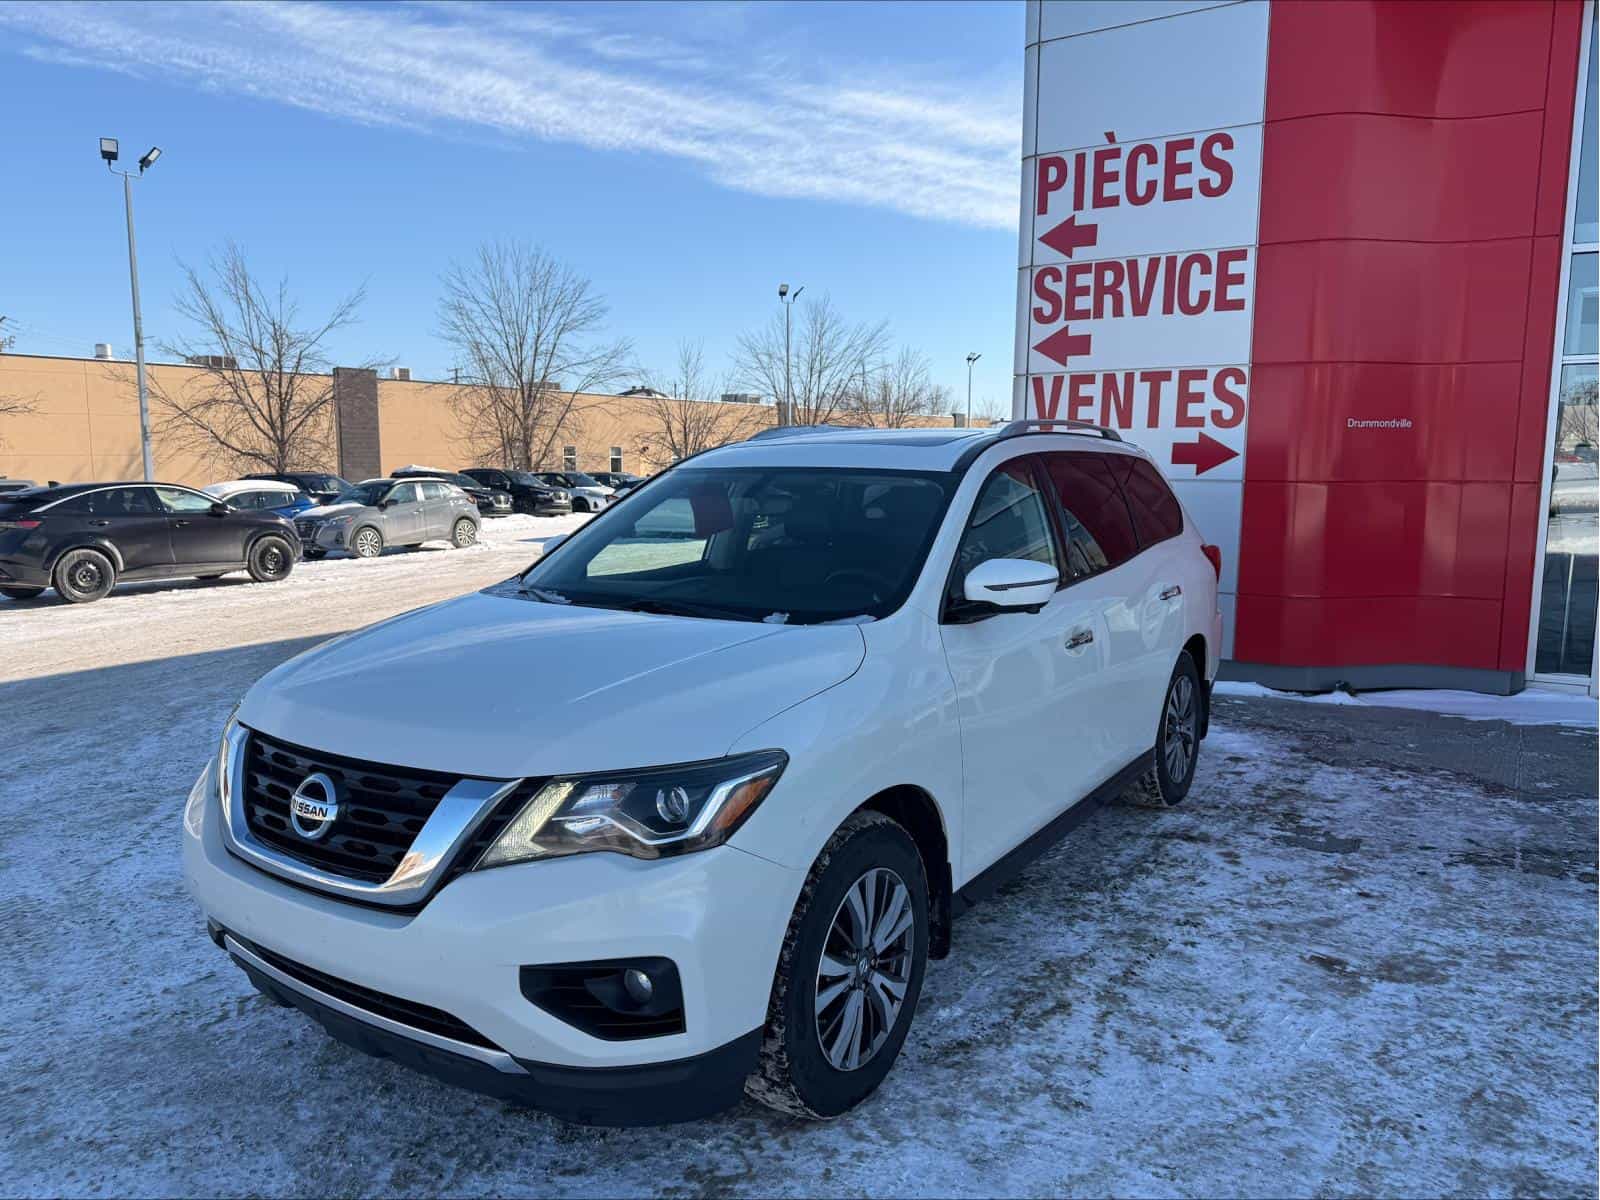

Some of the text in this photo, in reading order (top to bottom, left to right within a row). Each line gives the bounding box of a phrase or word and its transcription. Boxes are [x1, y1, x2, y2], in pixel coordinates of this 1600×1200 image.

[1037, 131, 1234, 216] PIÈCES
[1033, 248, 1248, 325] SERVICE
[1032, 367, 1247, 430] VENTES
[1347, 418, 1412, 428] Drummondville
